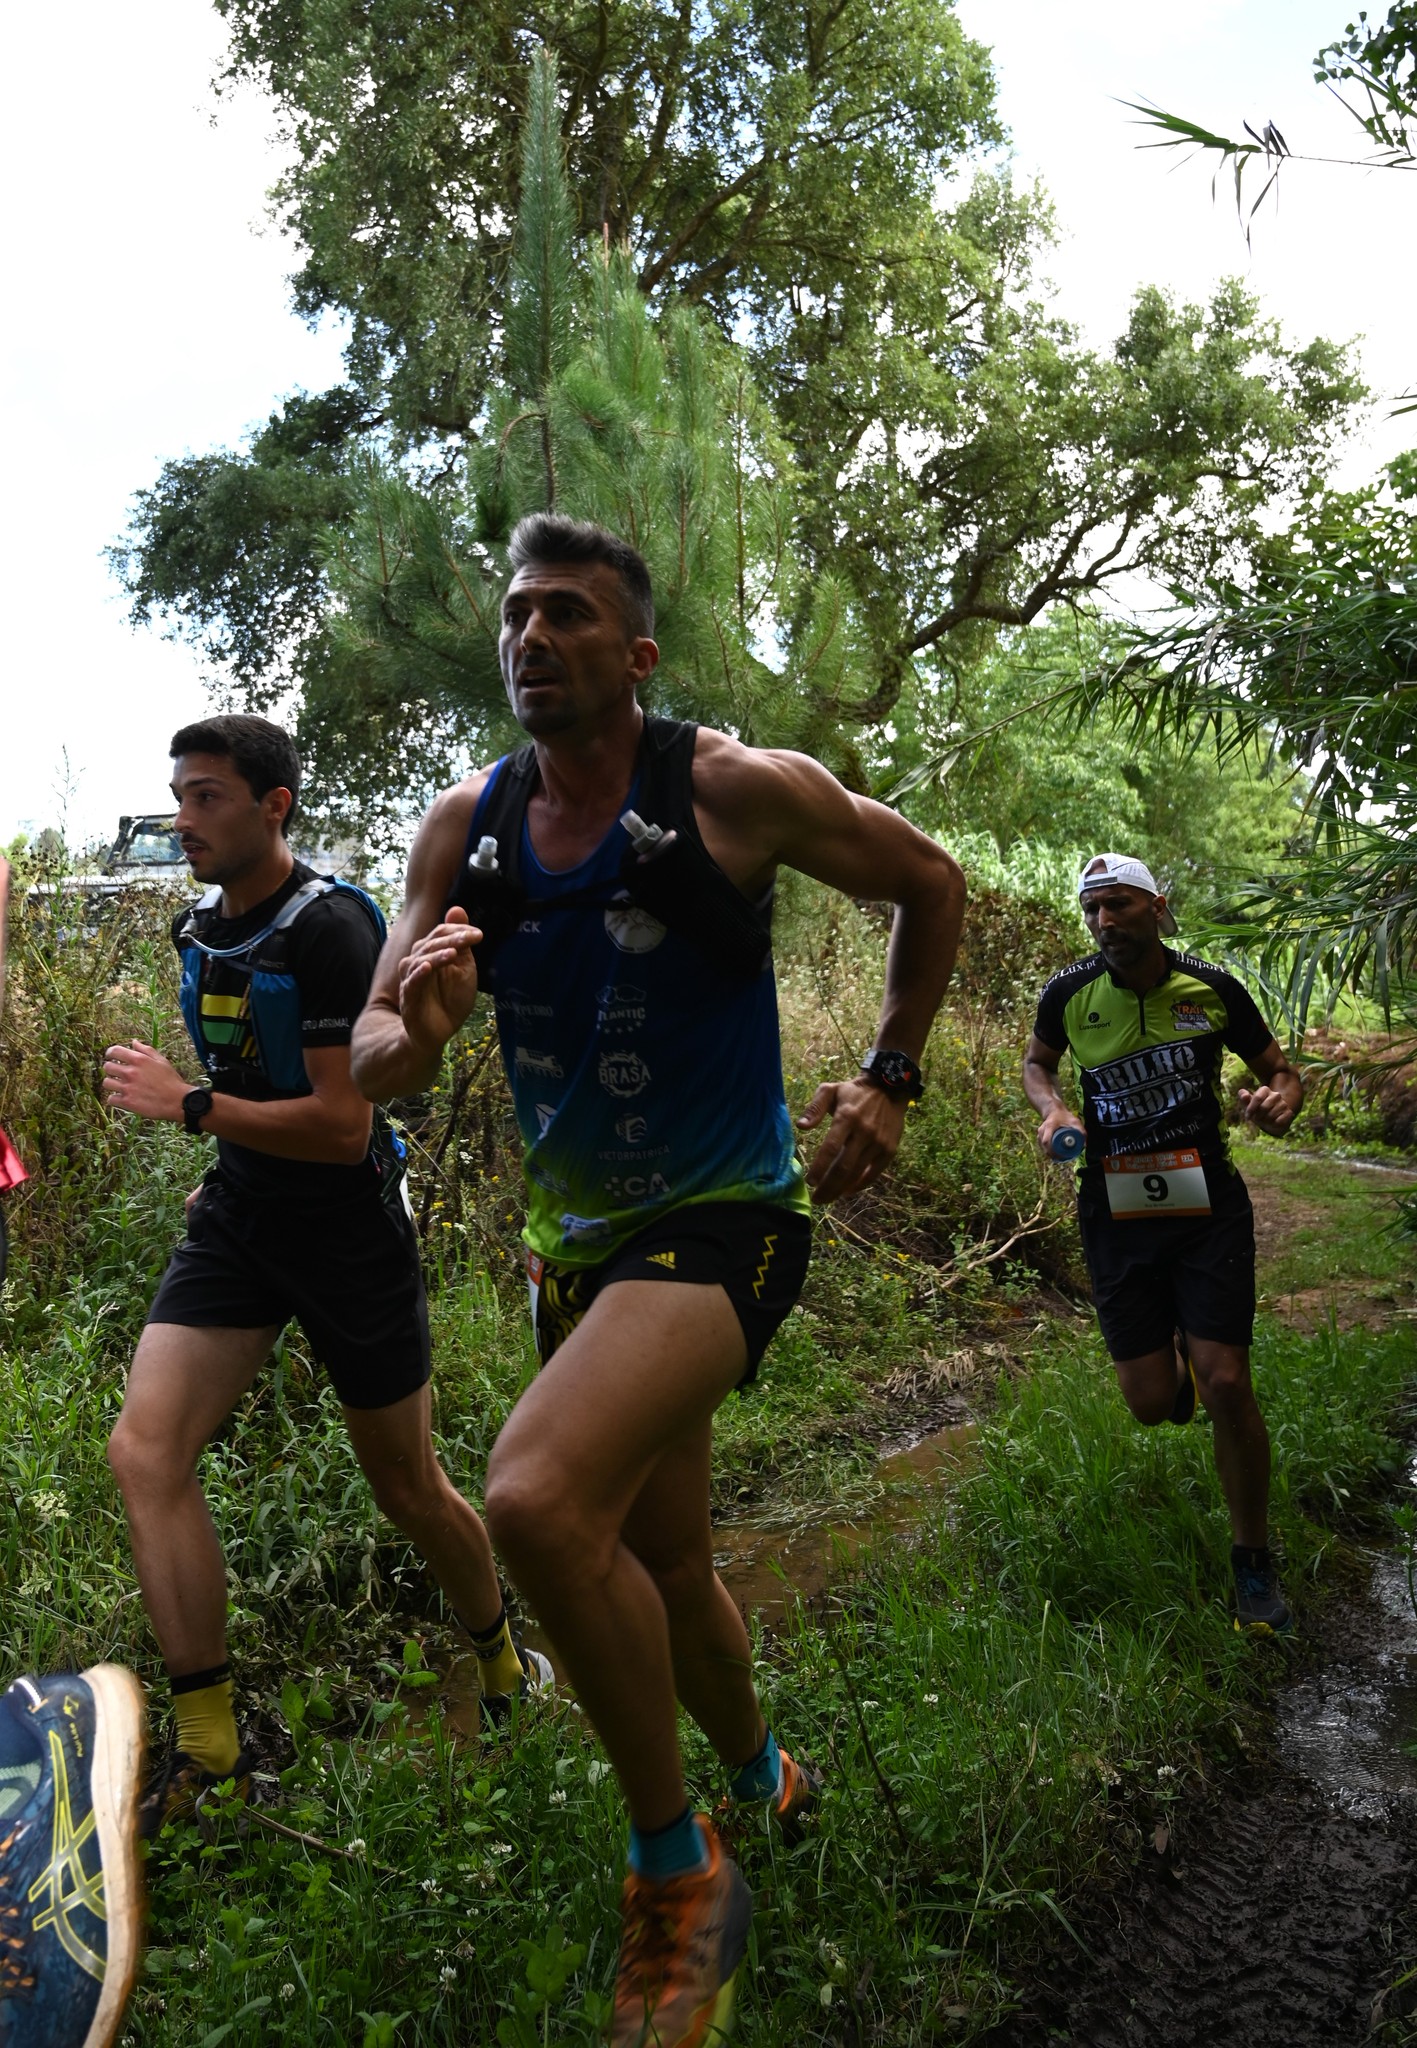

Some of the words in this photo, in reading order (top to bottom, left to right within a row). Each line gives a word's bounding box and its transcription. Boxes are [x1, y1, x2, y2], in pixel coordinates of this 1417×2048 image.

[599, 1065, 652, 1084] BRASA
[1091, 1046, 1195, 1092] TRILHO
[623, 1172, 671, 1197] CA
[1143, 1175, 1168, 1201] 9
